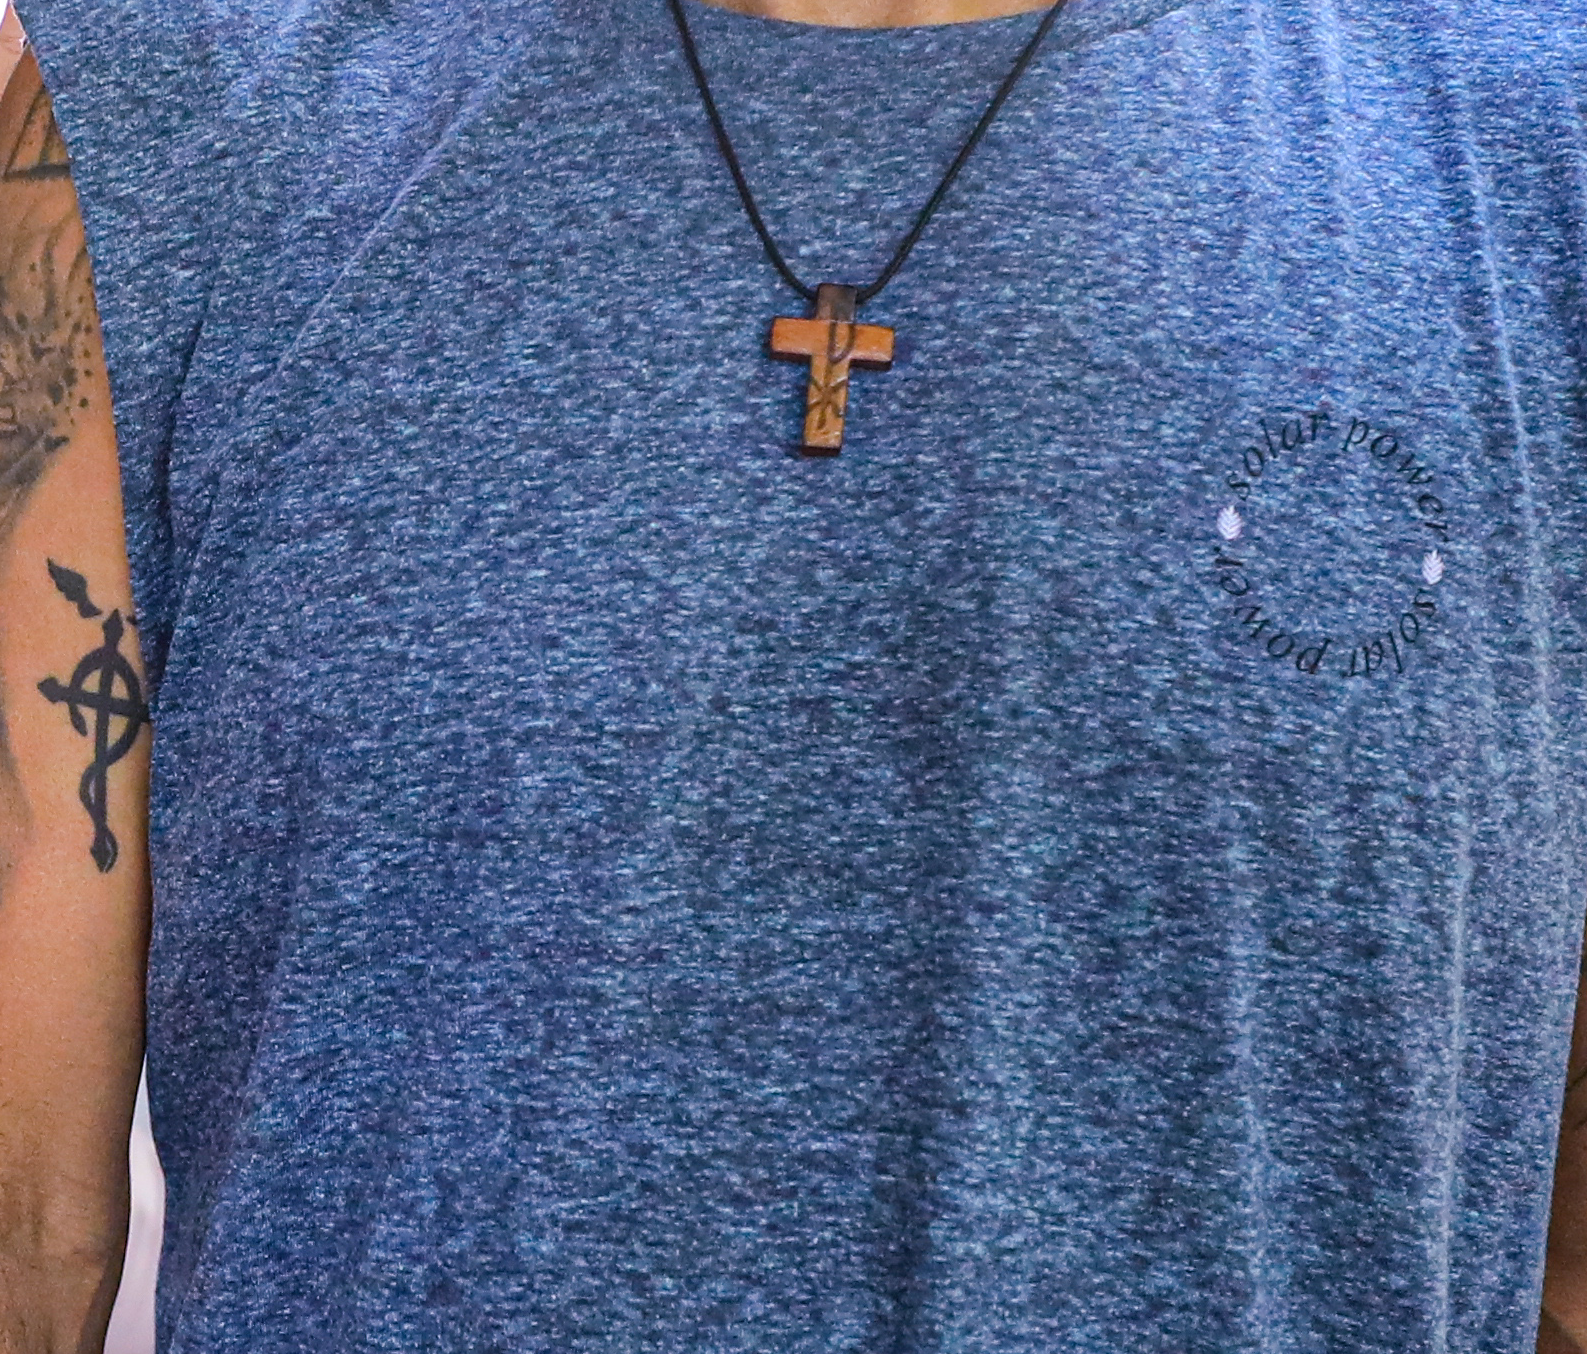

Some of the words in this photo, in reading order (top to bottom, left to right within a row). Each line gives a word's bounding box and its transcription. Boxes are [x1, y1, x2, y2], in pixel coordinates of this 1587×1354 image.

[1227, 412, 1328, 502] solar
[1340, 416, 1449, 542] power
[1214, 546, 1333, 675] power
[1341, 588, 1438, 678] solar
